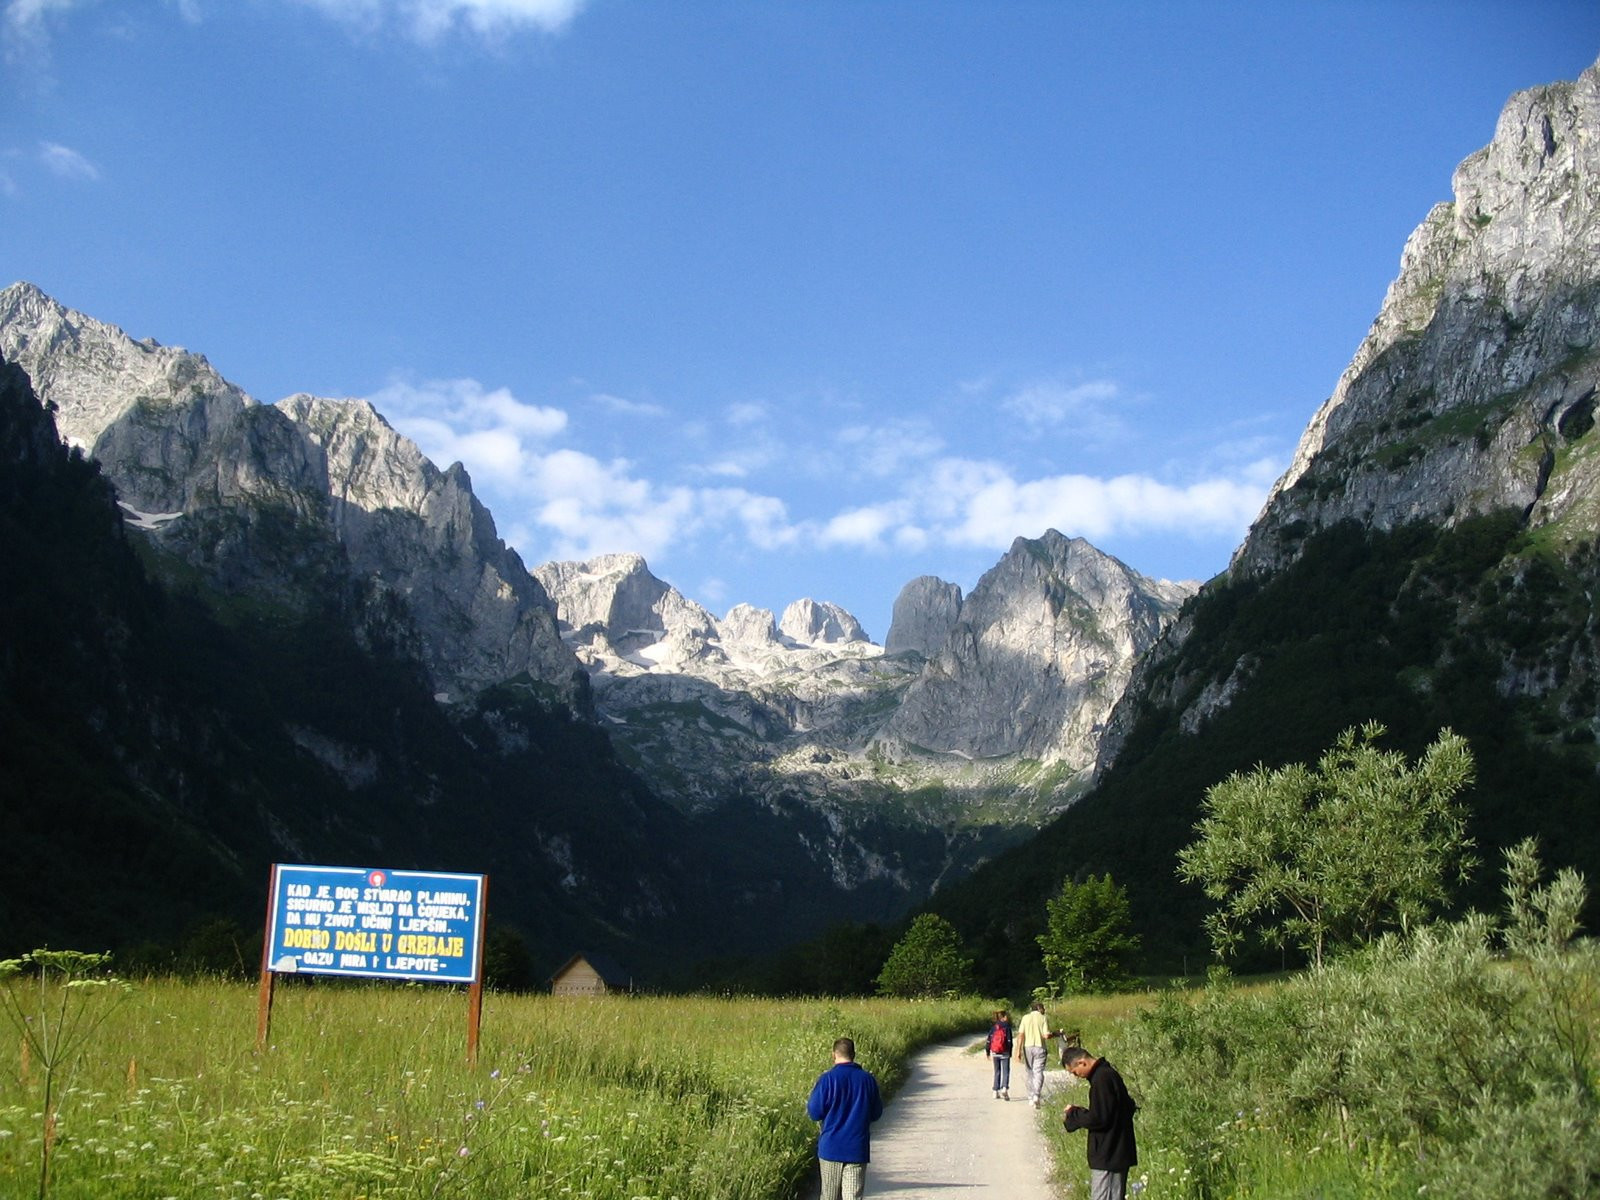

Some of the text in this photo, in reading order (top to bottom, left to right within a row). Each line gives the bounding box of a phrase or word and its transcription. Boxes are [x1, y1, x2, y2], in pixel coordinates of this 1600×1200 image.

[287, 884, 311, 897] KAD
[316, 886, 330, 898] JE
[335, 886, 359, 900] BOG
[364, 888, 412, 902] STVARAO
[286, 898, 335, 912] SIGURNO
[338, 901, 352, 913] JE
[398, 903, 413, 917] NA
[286, 912, 300, 924] DA
[304, 913, 320, 925] MU
[335, 929, 377, 952] DOŠLI
[382, 933, 393, 953] U
[397, 934, 464, 957] GREBAJE
[341, 954, 366, 968] MIRA
[373, 955, 378, 968] I
